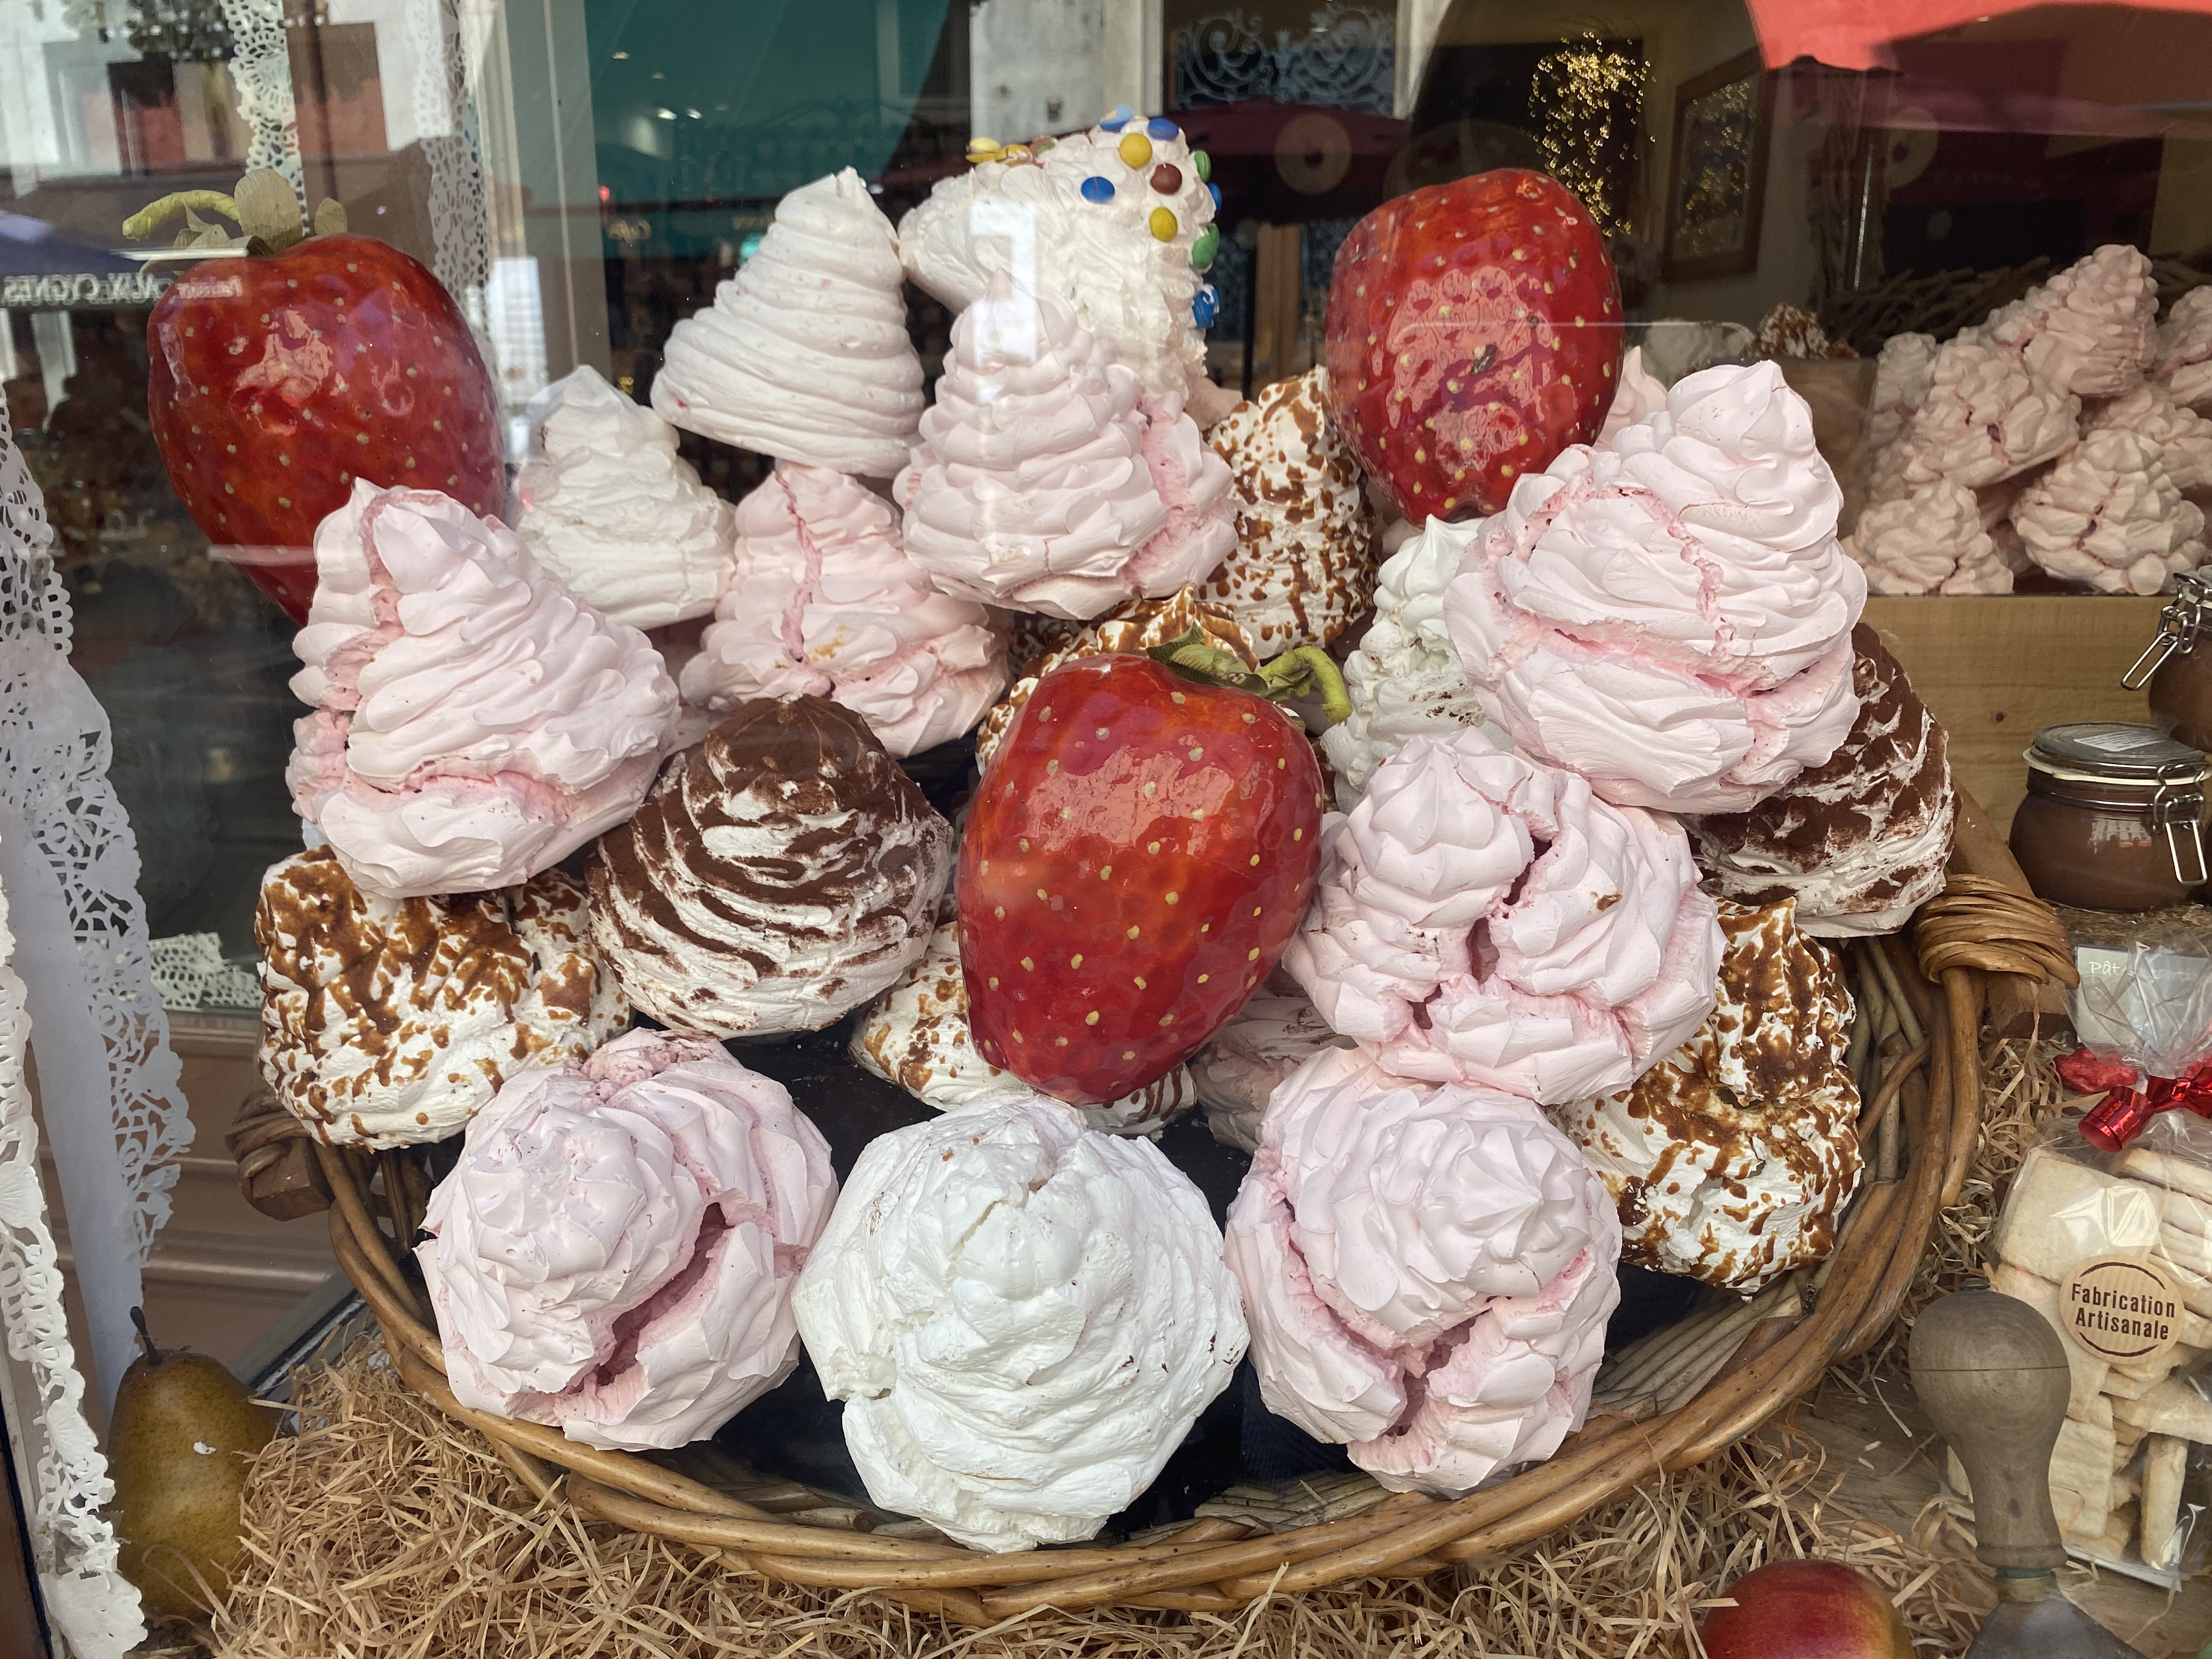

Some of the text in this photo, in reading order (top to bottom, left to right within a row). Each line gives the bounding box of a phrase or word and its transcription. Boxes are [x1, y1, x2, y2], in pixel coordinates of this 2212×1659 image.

[2089, 960, 2126, 975] Pât
[2071, 1283, 2175, 1318] Fabrication
[2075, 1307, 2169, 1340] Artisanale
